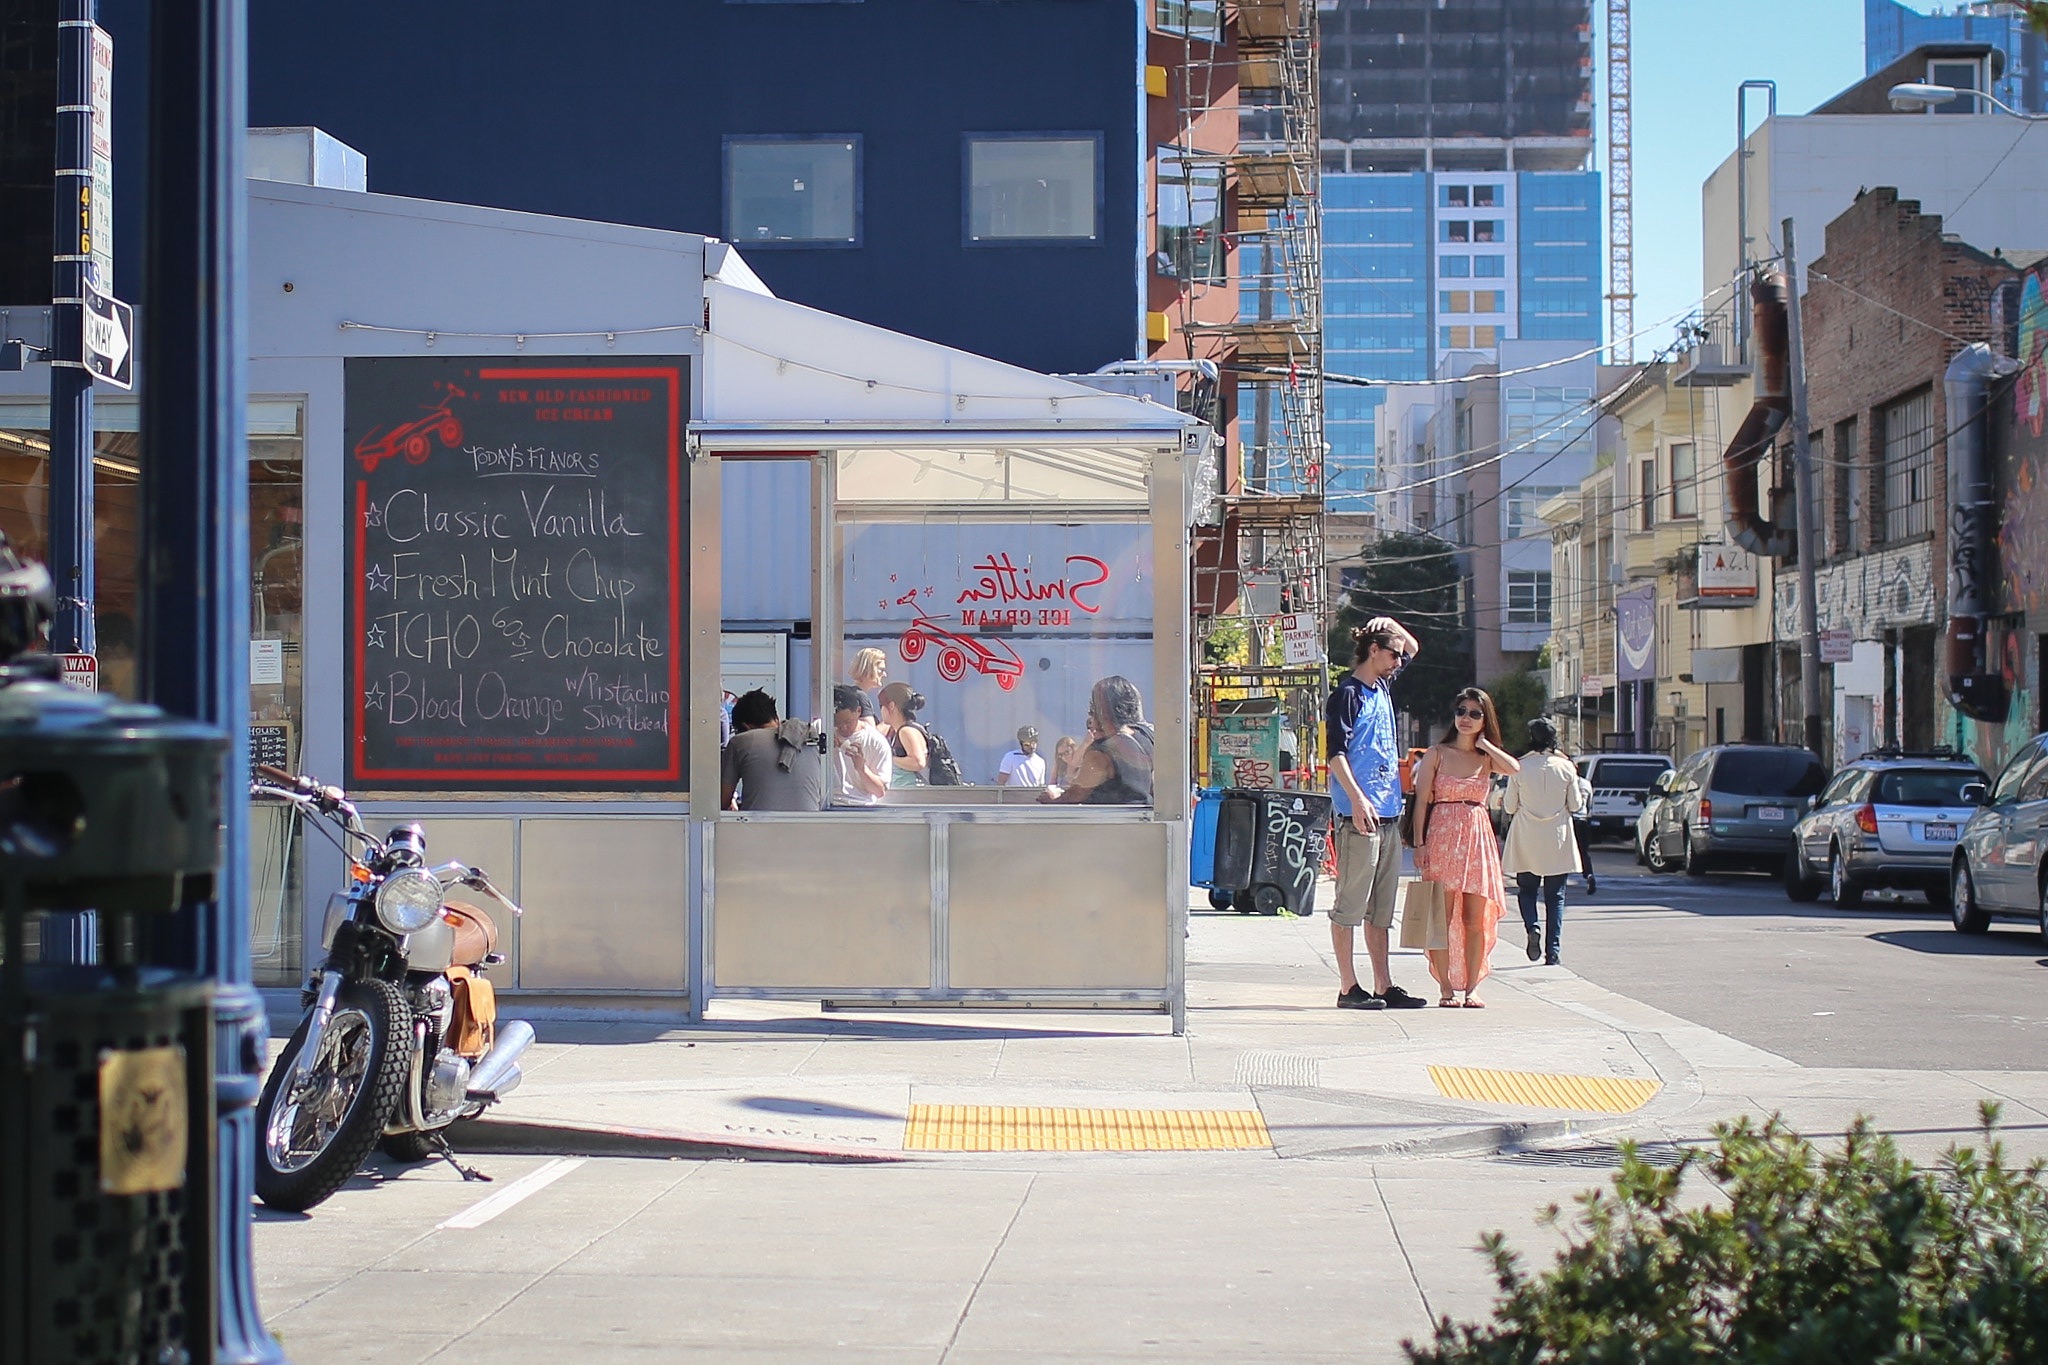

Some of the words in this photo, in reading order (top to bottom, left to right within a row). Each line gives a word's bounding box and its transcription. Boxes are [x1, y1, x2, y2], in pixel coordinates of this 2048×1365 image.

[81, 186, 90, 254] 416
[95, 319, 112, 354] WAY
[536, 408, 560, 421] ICE
[563, 408, 614, 421] CREAM
[527, 446, 600, 474] FLAVORS
[385, 489, 511, 542] Classic
[521, 485, 645, 538] Vanilla
[393, 552, 480, 600] Fresh
[491, 548, 552, 600] Mint
[566, 548, 636, 638] Chip
[1283, 617, 1295, 629] NO
[1285, 630, 1314, 641] PARKING
[375, 610, 481, 669] TCHO
[542, 614, 664, 661] Chocolate
[1293, 641, 1307, 650] ANY
[1294, 650, 1309, 658] TIME
[388, 671, 467, 727] Blood
[476, 672, 566, 735] Orange
[583, 705, 668, 736] Shortbread
